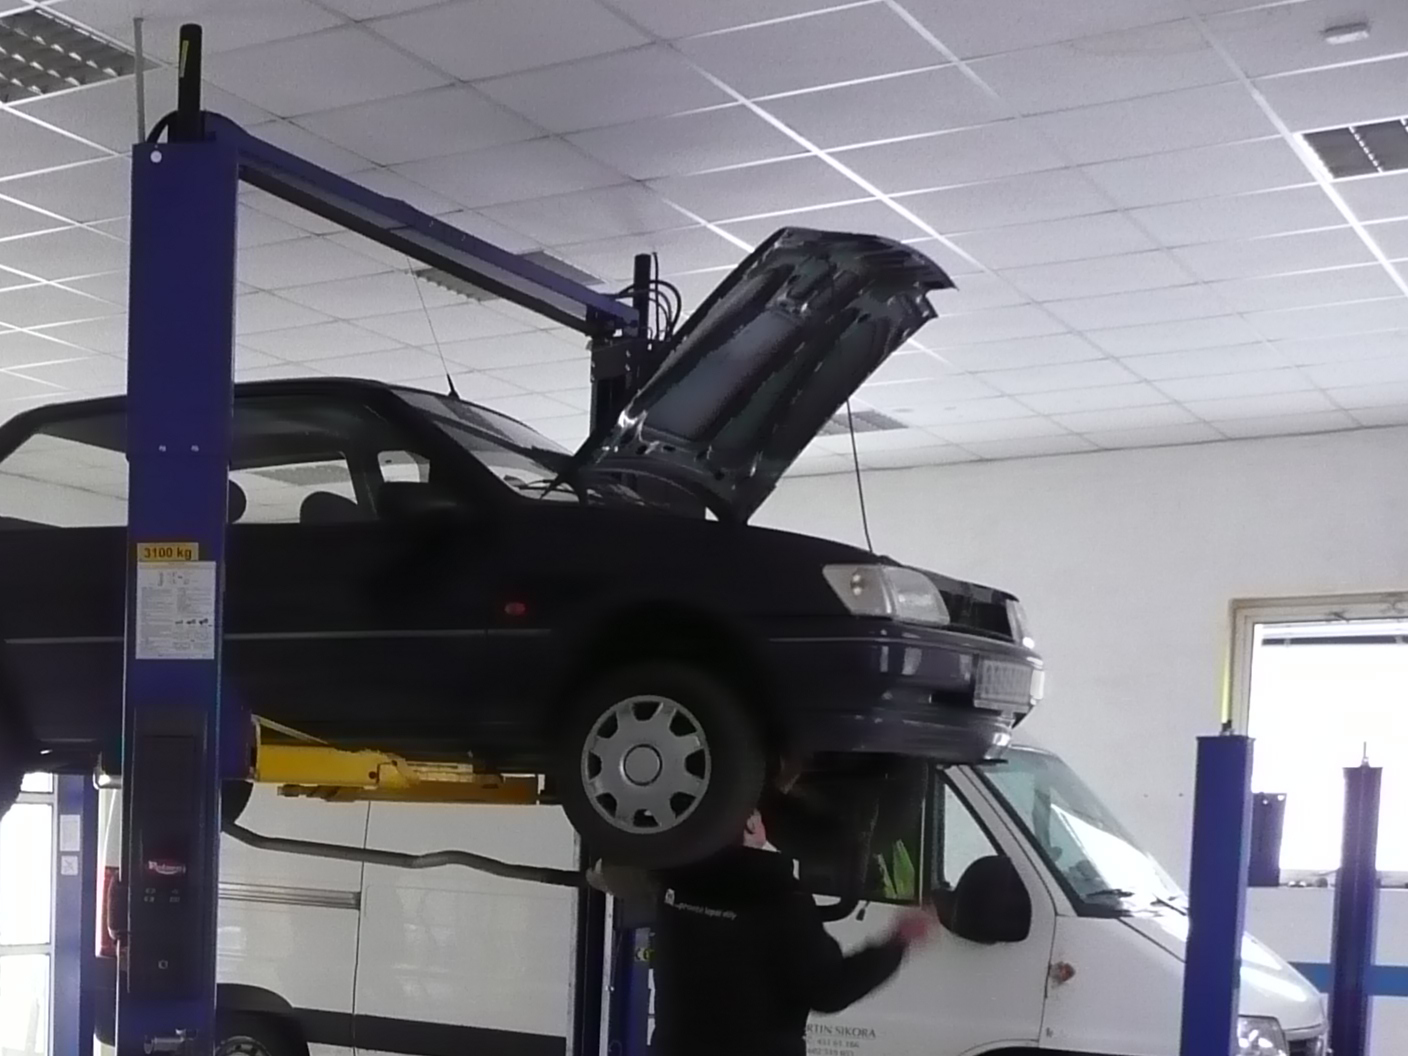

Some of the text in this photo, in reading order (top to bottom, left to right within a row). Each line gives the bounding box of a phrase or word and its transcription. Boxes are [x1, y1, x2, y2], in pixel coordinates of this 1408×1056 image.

[143, 547, 192, 560] 3100 kg
[835, 1026, 876, 1039] SIKORA
